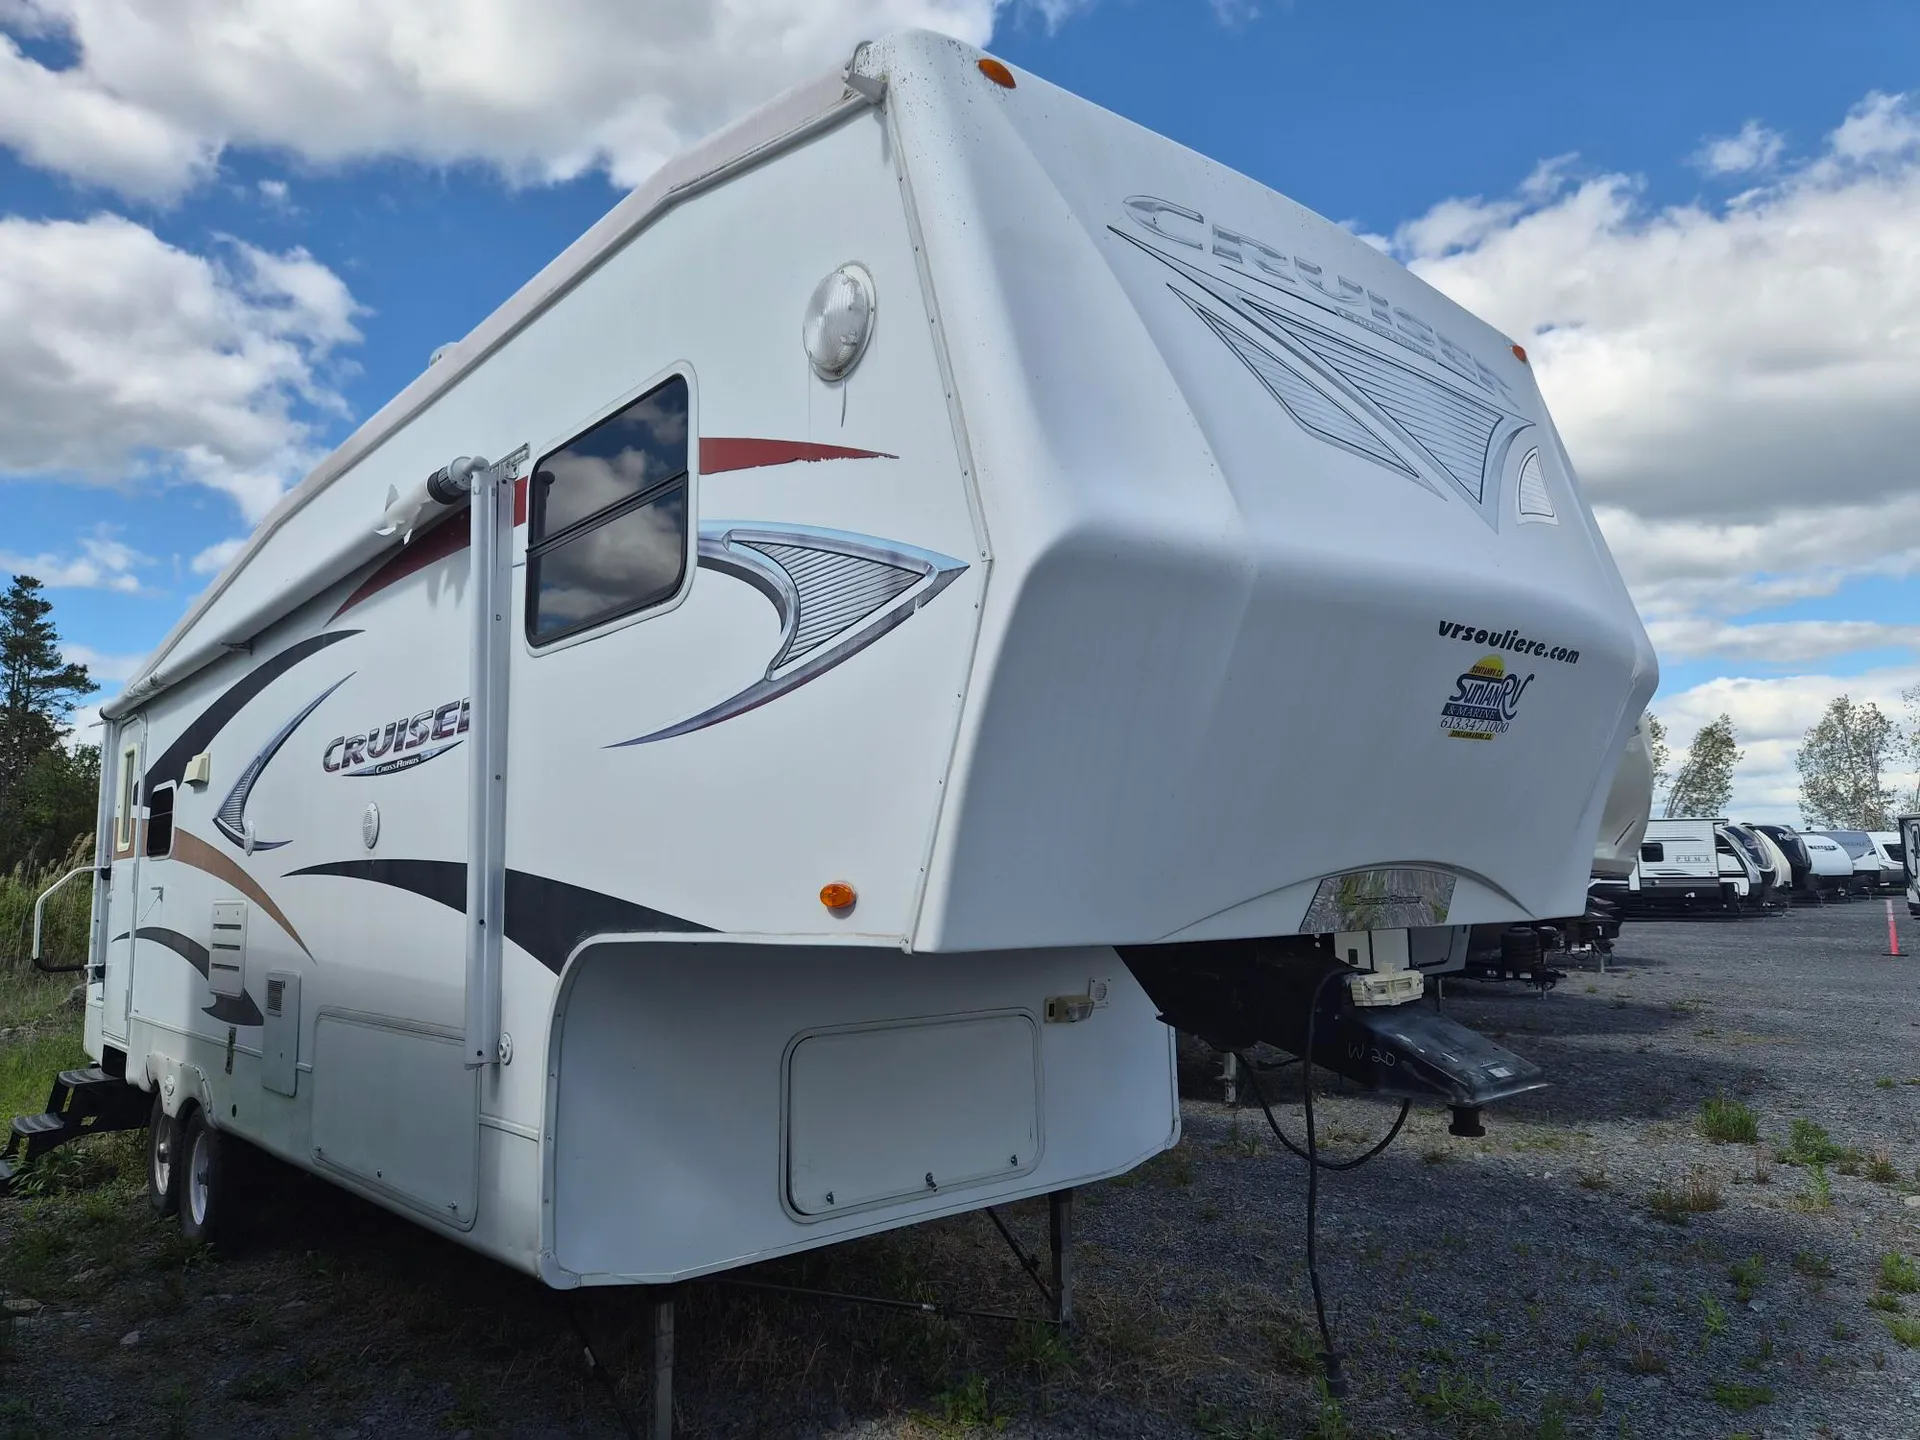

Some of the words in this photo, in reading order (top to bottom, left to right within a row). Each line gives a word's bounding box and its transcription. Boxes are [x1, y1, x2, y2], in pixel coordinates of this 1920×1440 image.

[1438, 620, 1580, 664] vrsouliere.com
[1456, 705, 1498, 720] MARINE
[1440, 716, 1510, 734] 613.347.1000
